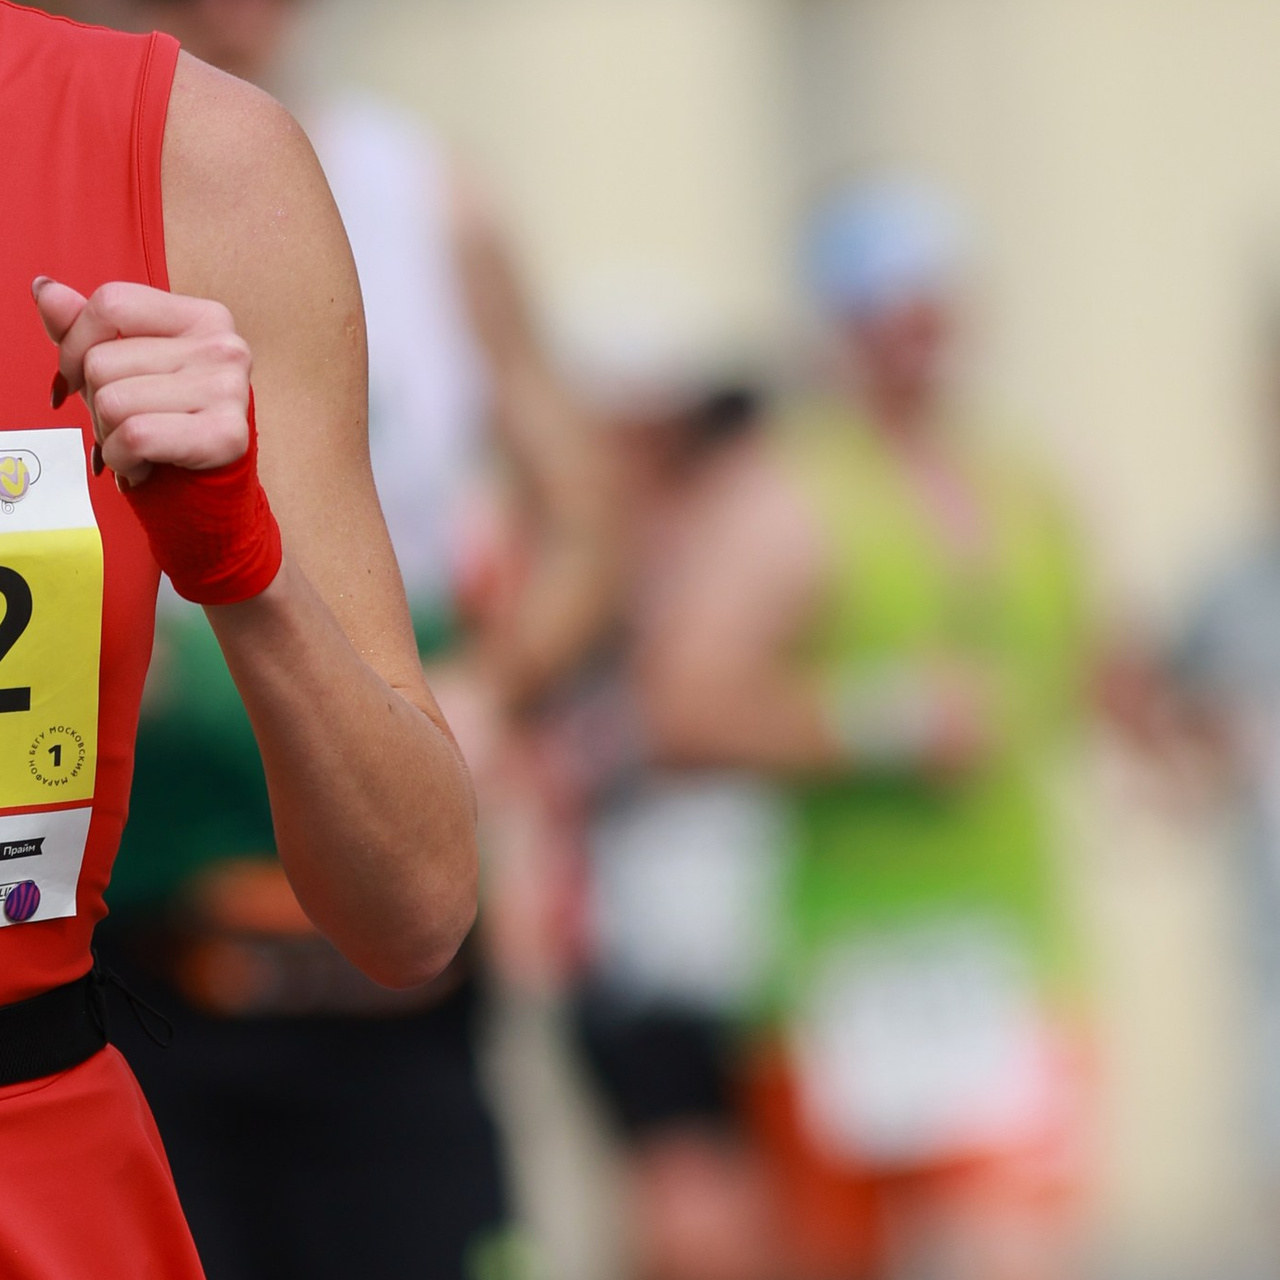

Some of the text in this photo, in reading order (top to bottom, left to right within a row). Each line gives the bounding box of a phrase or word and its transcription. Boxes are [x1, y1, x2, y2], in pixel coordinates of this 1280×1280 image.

[28, 725, 86, 787] БЕГУ МОСКОВСКИЙ МАРАФОН
[47, 744, 62, 767] 1
[3, 843, 36, 857] Прайм
